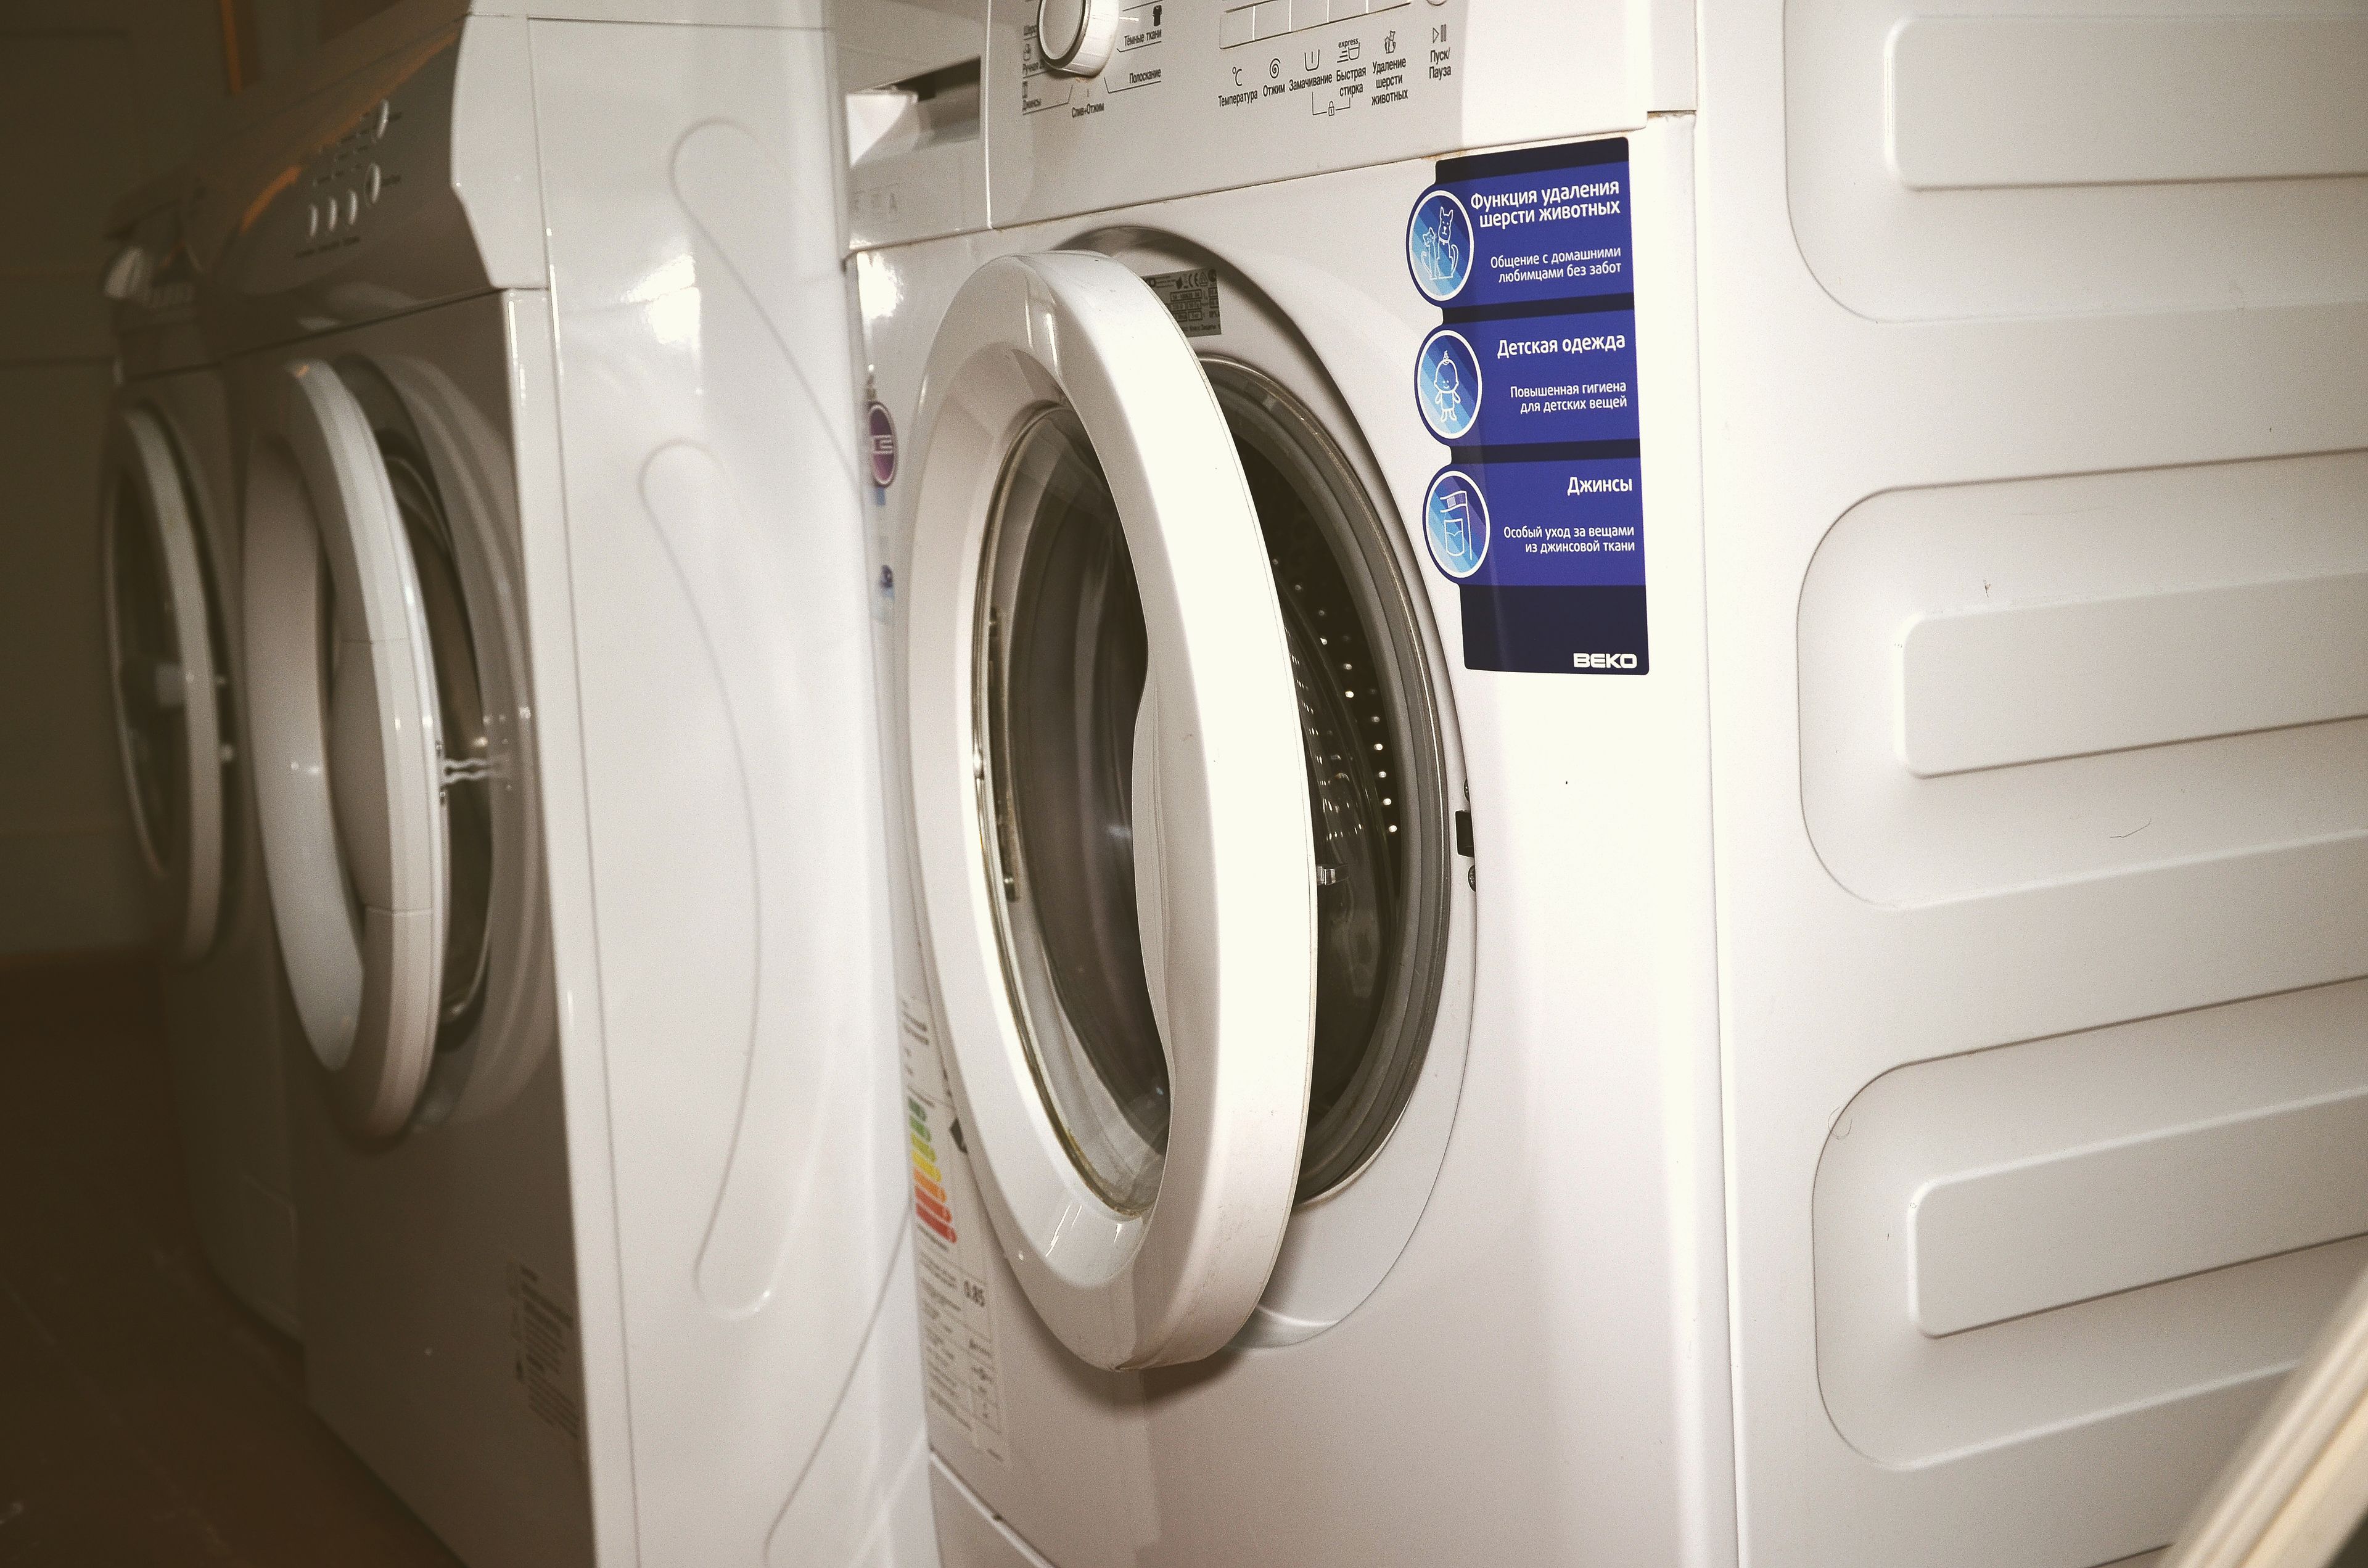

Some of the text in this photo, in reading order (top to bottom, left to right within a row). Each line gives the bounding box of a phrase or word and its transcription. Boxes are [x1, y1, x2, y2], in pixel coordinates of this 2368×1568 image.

[1124, 29, 1162, 47] Тёмные ткани
[1338, 38, 1359, 48] express
[1430, 46, 1450, 65] Пуск/
[1336, 67, 1367, 81] Быстрая
[1372, 58, 1407, 75] Удаление
[1429, 65, 1452, 80] Пауза
[1129, 68, 1161, 84] Полоскание
[1289, 73, 1333, 91] Замачивание
[1376, 75, 1403, 90] шерсти
[1218, 90, 1257, 107] Температура
[1263, 84, 1285, 97] Отжим
[1339, 83, 1363, 97] стирка
[1371, 89, 1408, 106] животных
[1470, 181, 1619, 212] Функция удаления
[1479, 200, 1621, 229] шерсти животных
[1490, 247, 1621, 269] Общение с домашними
[1498, 261, 1622, 283] любимцами без забот
[1497, 334, 1626, 358] Детская одежда
[1510, 382, 1627, 398] Повышенная гигиена
[1520, 395, 1627, 414] для детских вещей
[1567, 476, 1633, 496] Джинсы
[1503, 525, 1634, 539] Особый уход за вещами
[1525, 540, 1635, 554] из джинсовой ткани
[1573, 653, 1637, 668] BEKO
